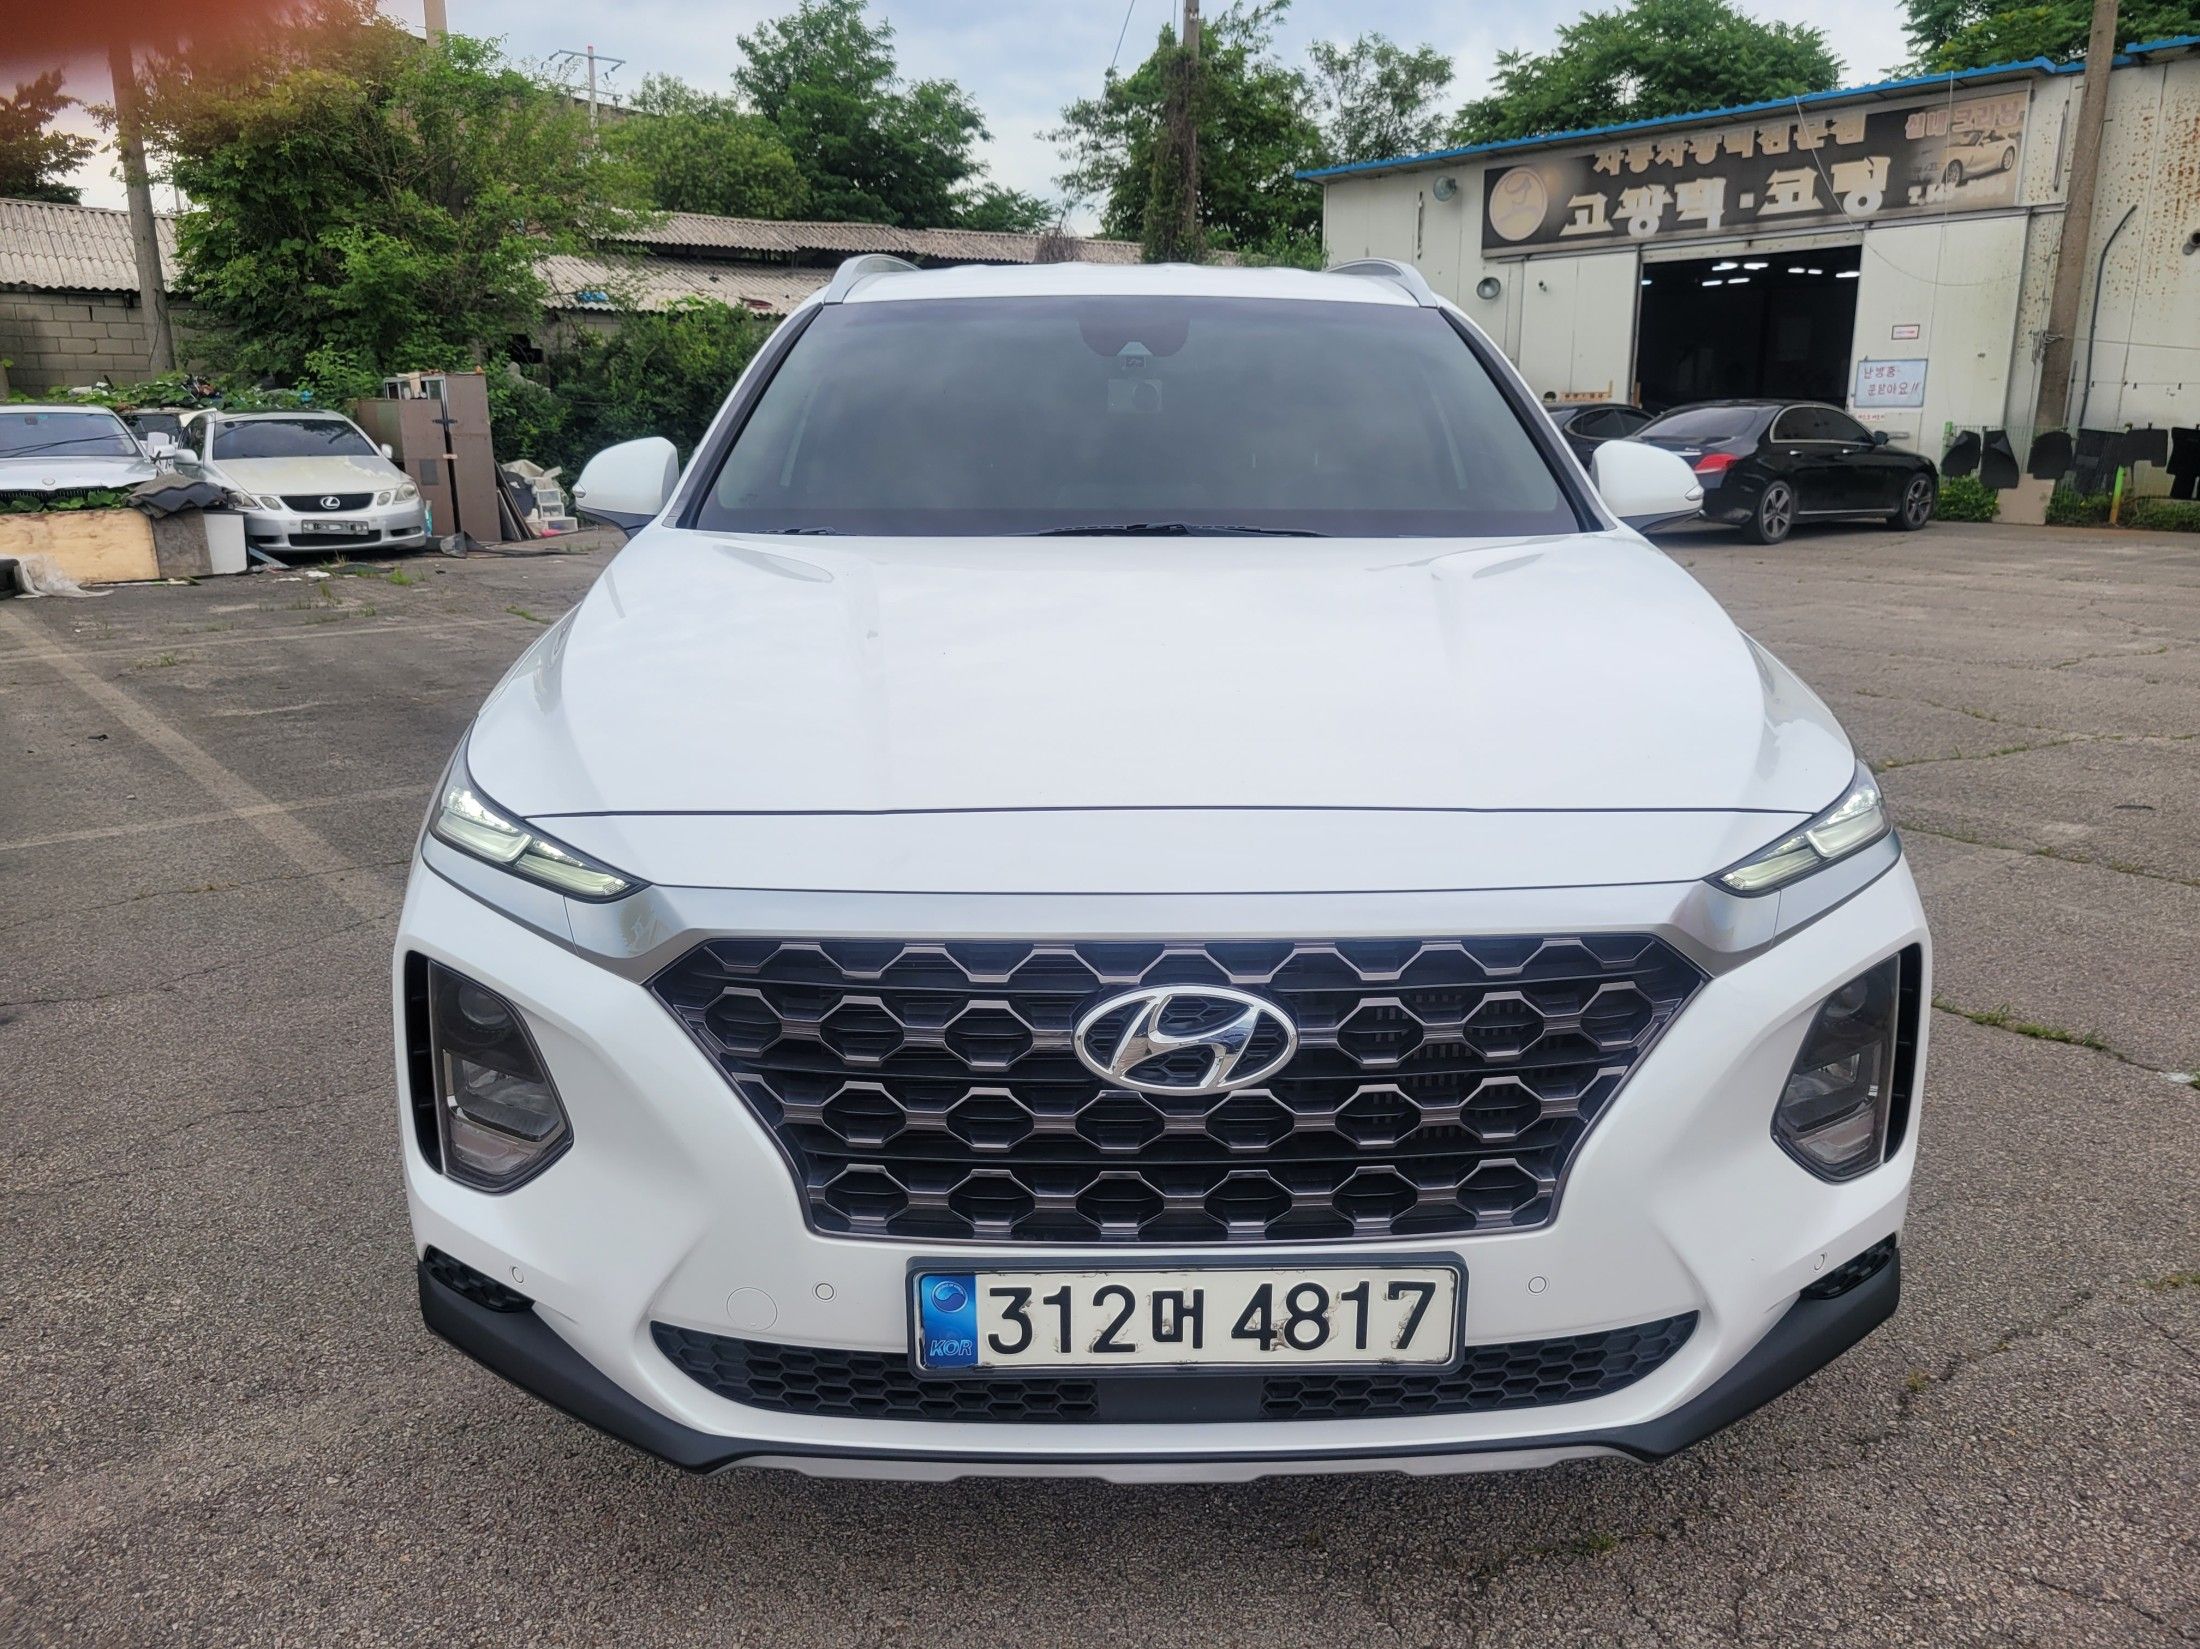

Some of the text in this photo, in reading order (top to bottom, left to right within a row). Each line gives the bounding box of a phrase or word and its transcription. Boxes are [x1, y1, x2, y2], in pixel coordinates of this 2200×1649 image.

[987, 1281, 1436, 1355] 312머 4817
[929, 1339, 973, 1357] KOR
